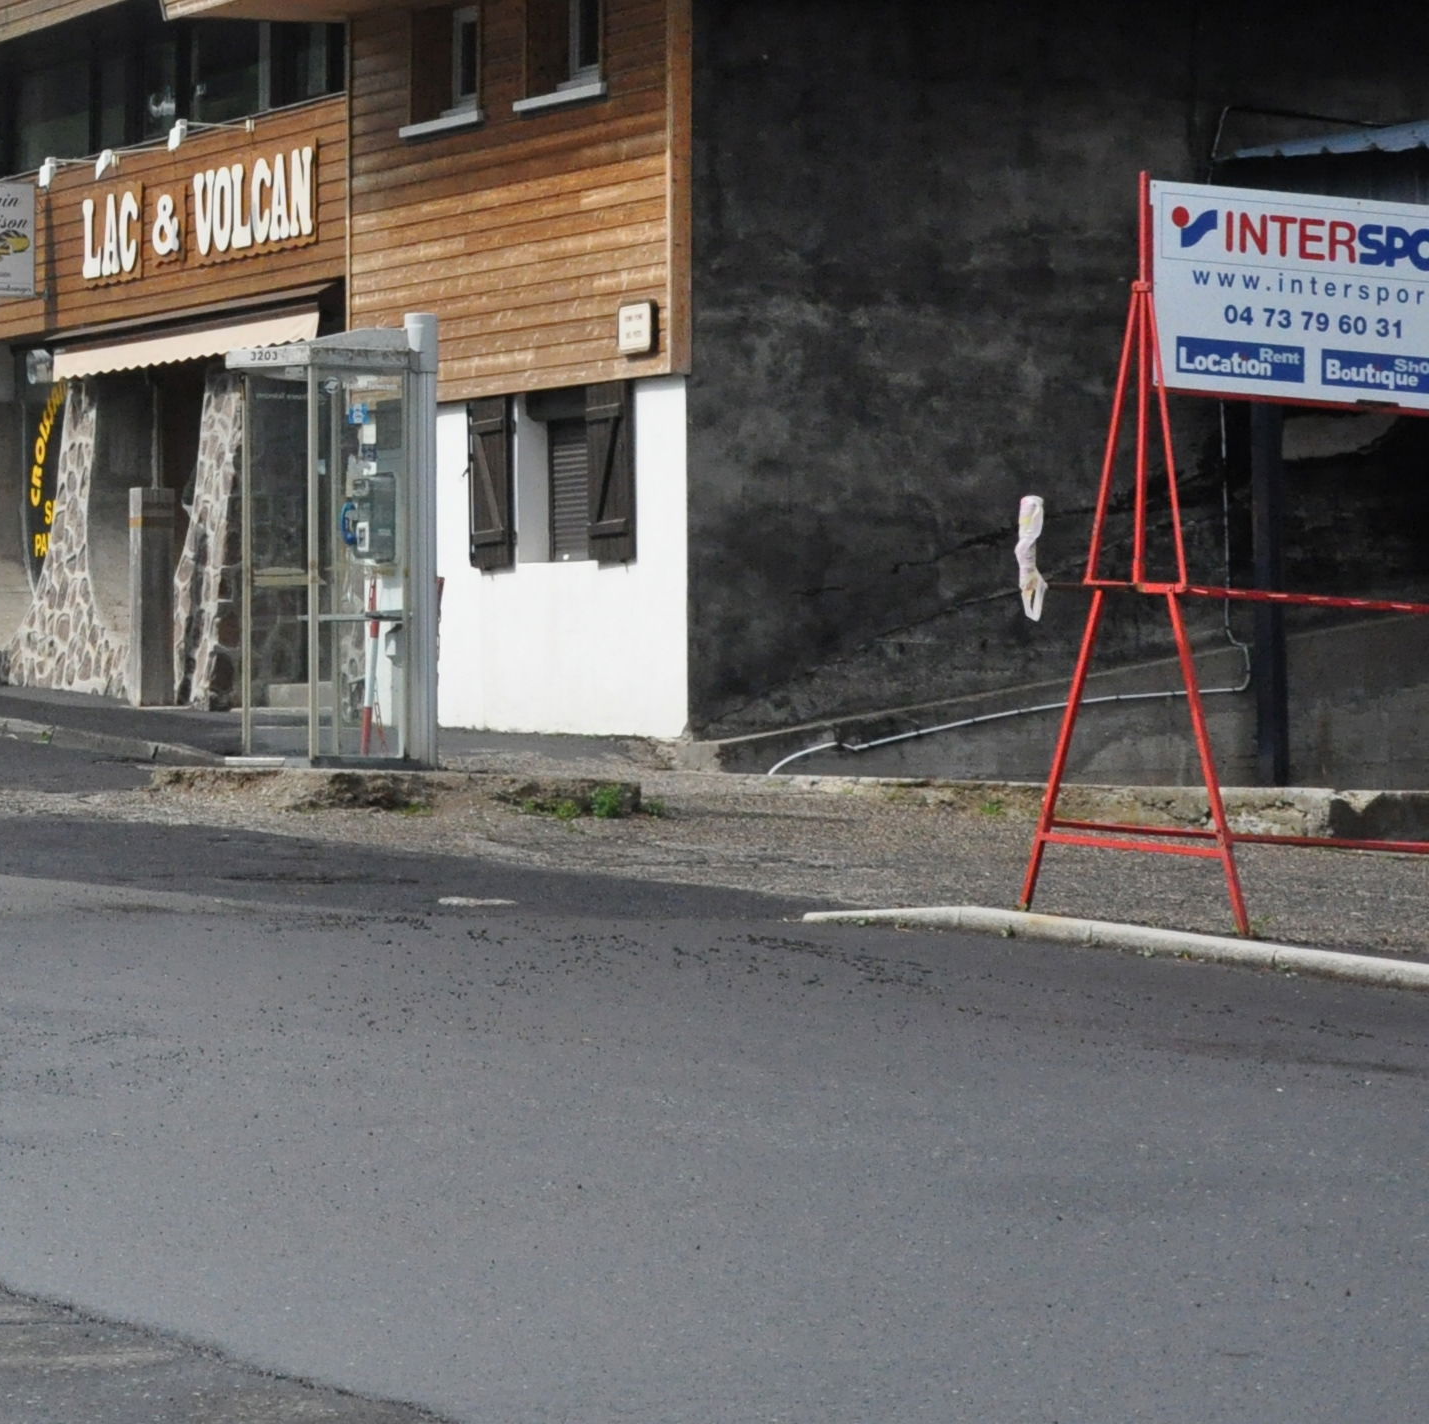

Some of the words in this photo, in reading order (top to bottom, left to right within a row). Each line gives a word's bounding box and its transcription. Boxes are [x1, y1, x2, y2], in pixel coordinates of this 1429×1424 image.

[82, 191, 138, 279] LAC
[152, 194, 180, 256] &
[193, 146, 313, 256] VOLCAN
[1224, 304, 1254, 326] 04
[1262, 307, 1292, 329] 73
[1301, 311, 1330, 332] 79
[1338, 314, 1367, 336] 60
[1375, 318, 1403, 339] 31
[250, 350, 278, 361] 3203
[1259, 347, 1301, 365] Rent
[1325, 358, 1419, 390] Boutique
